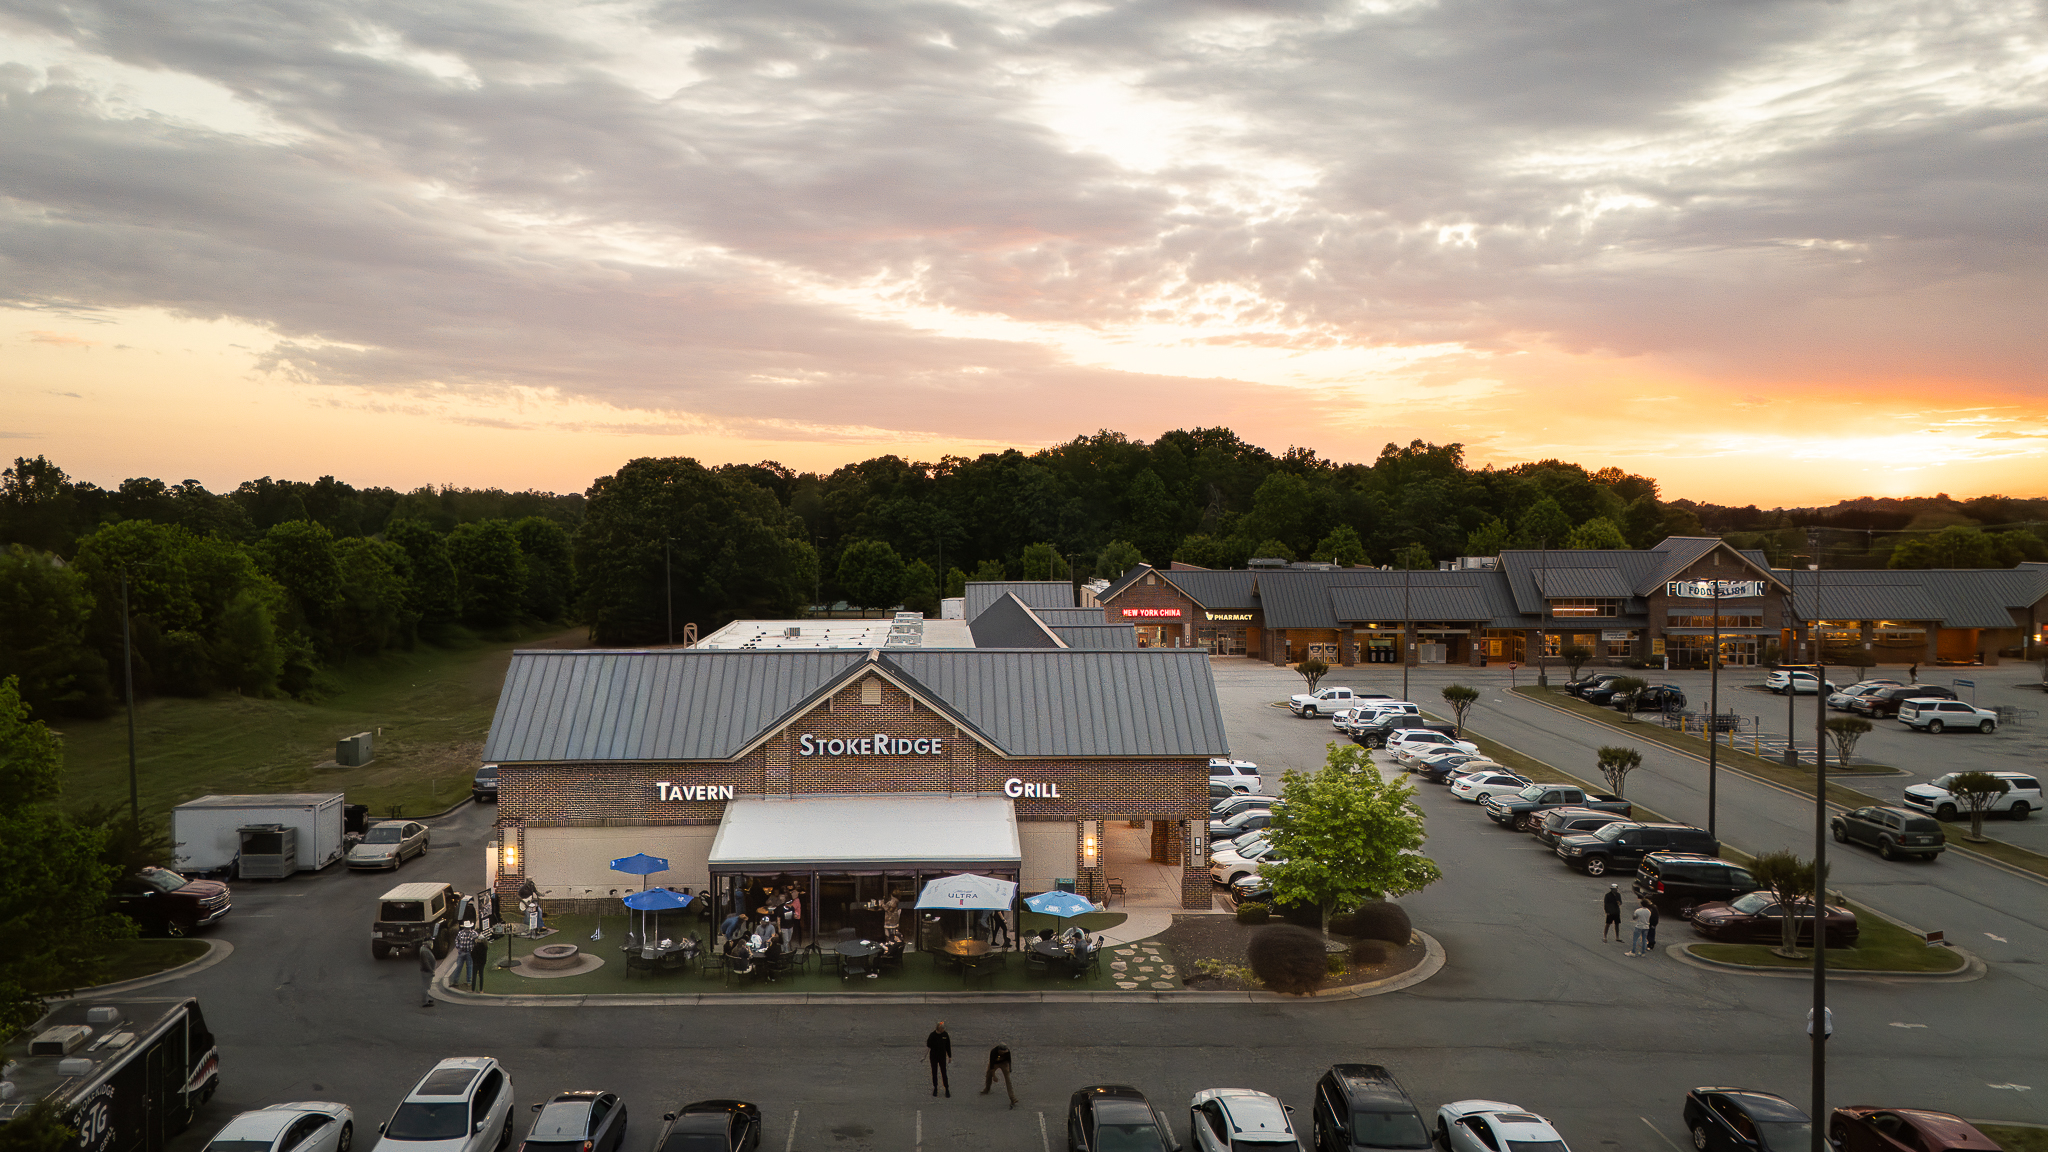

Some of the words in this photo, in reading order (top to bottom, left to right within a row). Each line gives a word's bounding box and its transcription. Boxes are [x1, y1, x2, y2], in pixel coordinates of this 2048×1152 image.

[1122, 608, 1138, 617] NEW
[1139, 608, 1159, 617] YORK
[1159, 608, 1181, 617] CHINA
[799, 733, 942, 756] STOKERIDGE
[656, 782, 734, 801] TAVERN
[1004, 778, 1061, 798] GRILL
[73, 1083, 116, 1127] STOKERIDGE
[80, 1101, 107, 1148] STG
